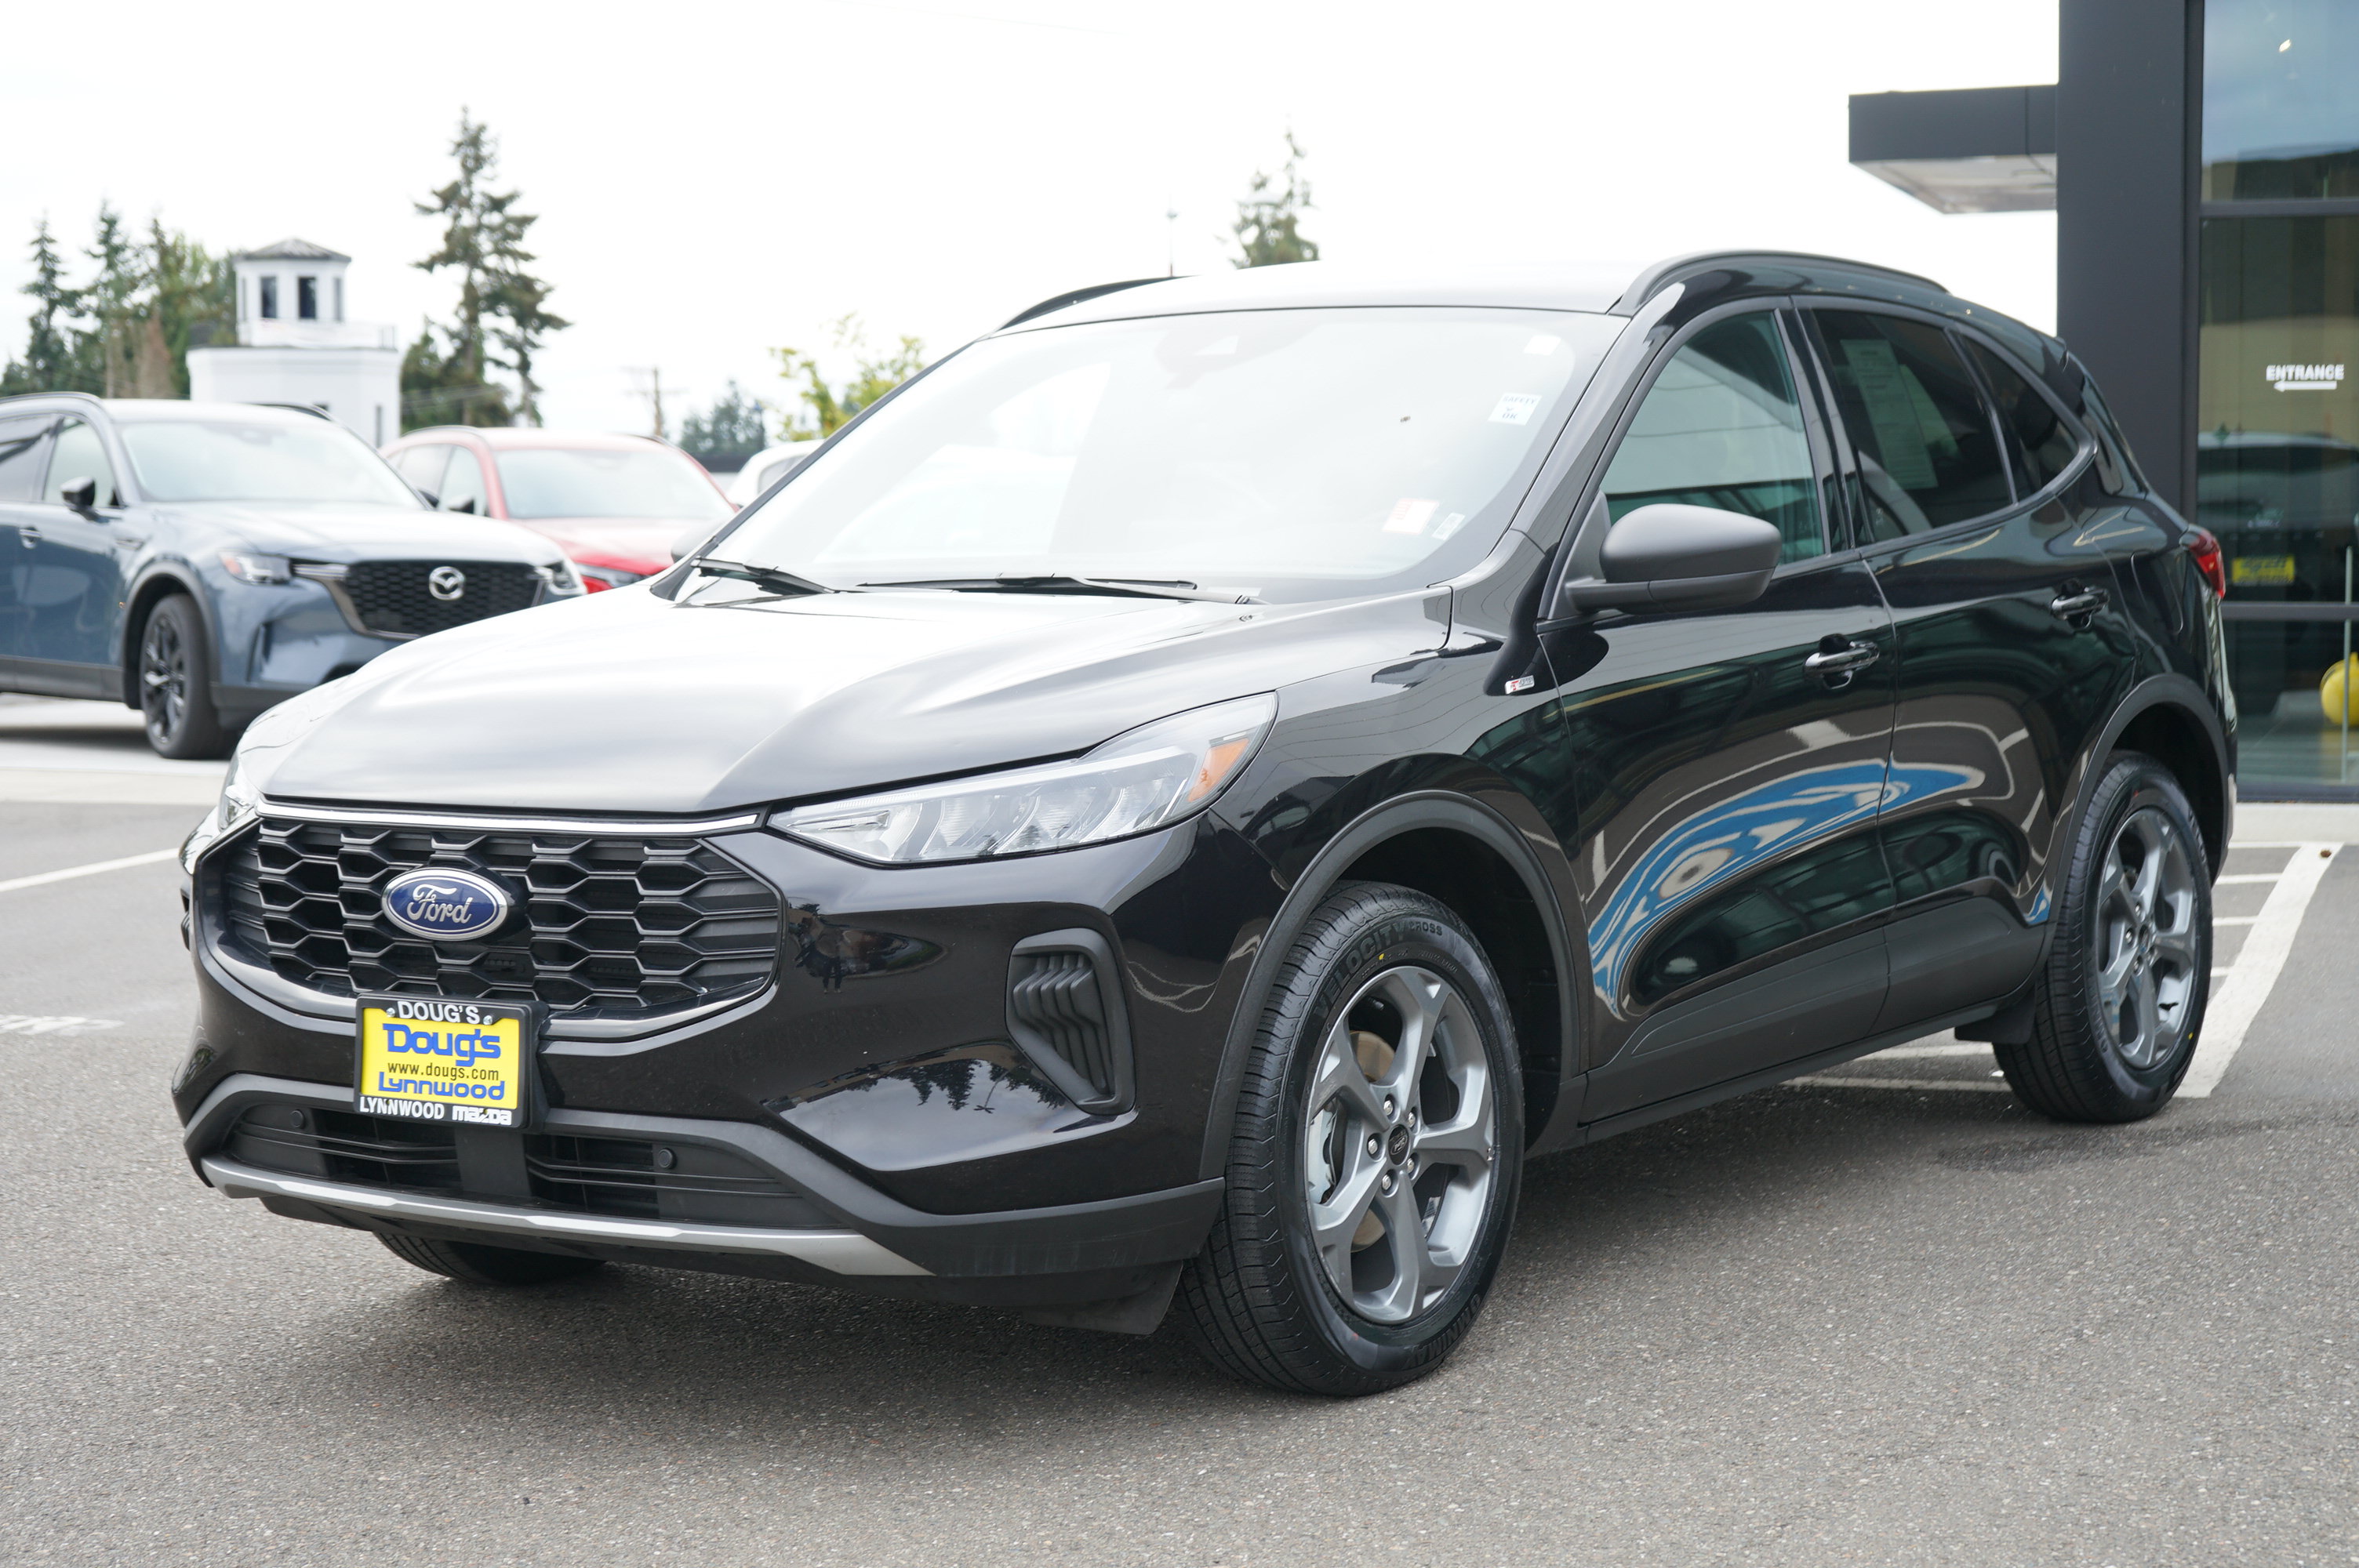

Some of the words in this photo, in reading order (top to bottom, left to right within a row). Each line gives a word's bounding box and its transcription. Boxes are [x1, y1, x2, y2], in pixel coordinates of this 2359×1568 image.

[2266, 364, 2345, 380] ENTRANCE
[406, 884, 473, 924] Ford
[1313, 921, 1405, 1018] VELOCITY
[1405, 921, 1443, 936] CROSS
[397, 1001, 481, 1025] DOUG'S
[382, 1023, 501, 1067] Doug's
[387, 1062, 500, 1081] www.dougs.com
[378, 1071, 505, 1101] Lynnwood
[359, 1096, 445, 1120] LYNNWOOD
